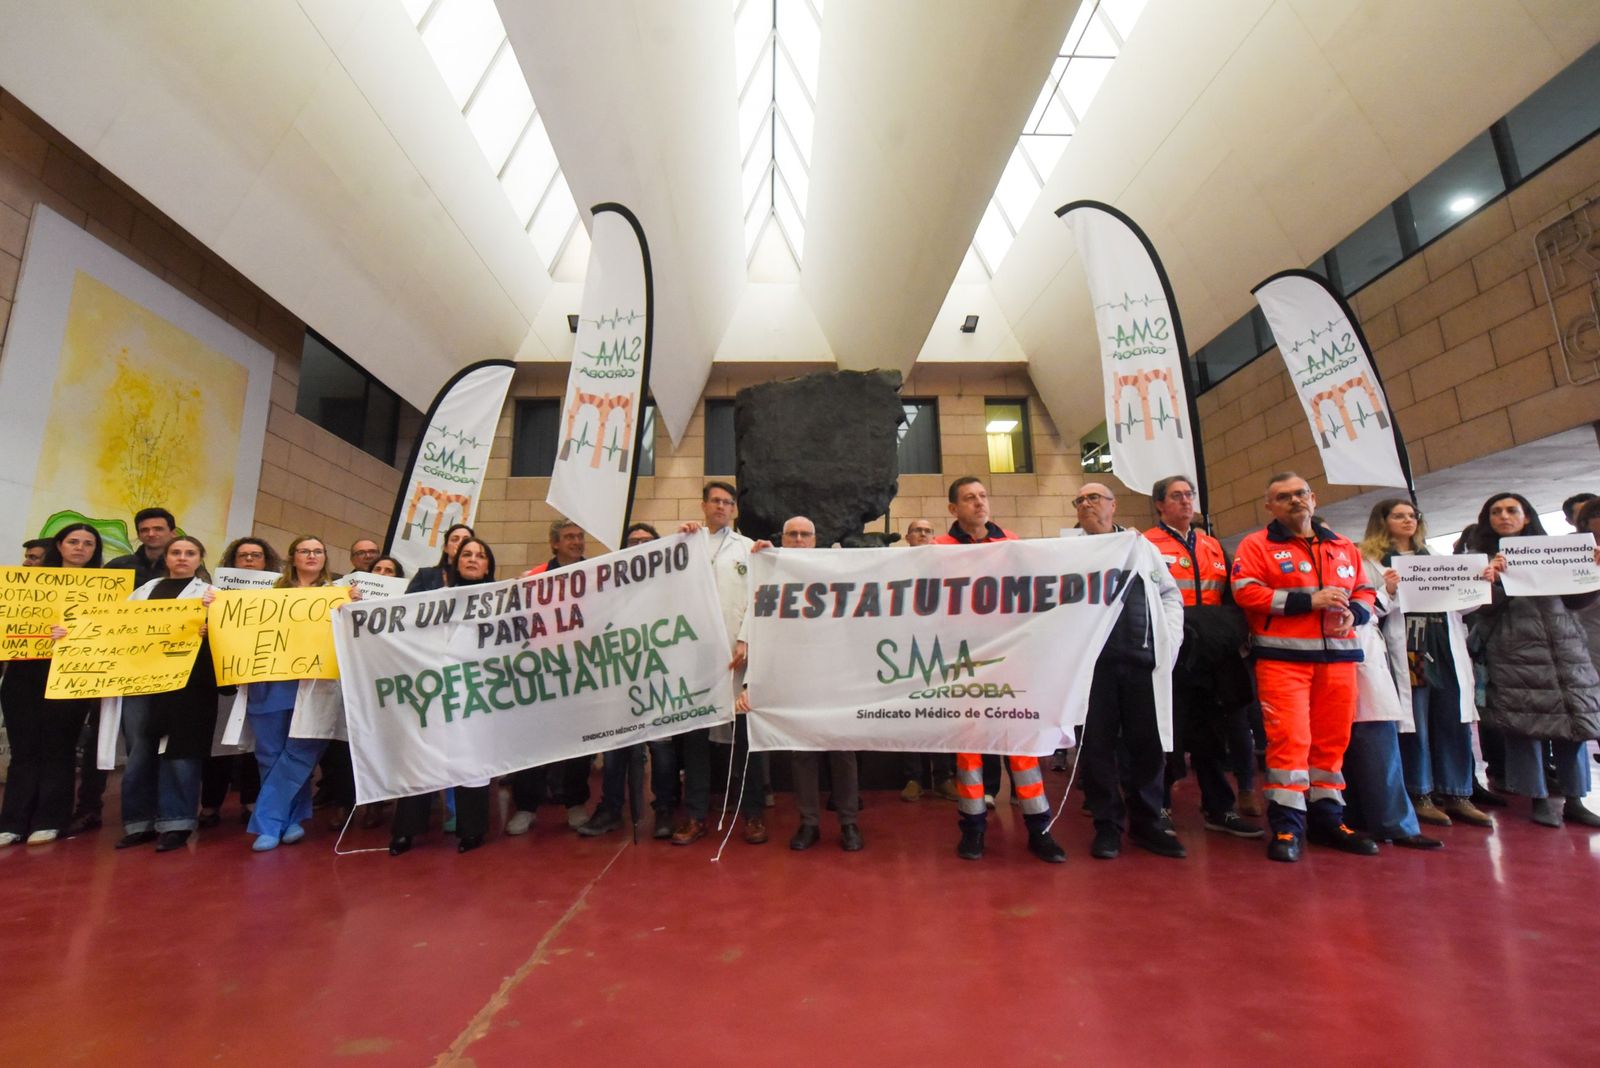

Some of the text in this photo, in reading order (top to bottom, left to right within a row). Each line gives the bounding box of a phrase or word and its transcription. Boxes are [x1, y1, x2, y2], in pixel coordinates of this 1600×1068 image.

[424, 441, 479, 475] SMA
[1543, 544, 1594, 555] quemado
[1539, 555, 1594, 566] colapsado
[1433, 564, 1455, 572] años
[1456, 564, 1469, 572] de
[5, 571, 127, 592] UN CONDUCTOR
[219, 575, 251, 585] “Faltan
[1401, 574, 1426, 583] tudio,
[351, 542, 689, 638] POR UN ESTATUTO PROPIO
[370, 590, 389, 598] para
[1431, 584, 1455, 592] mes”
[64, 590, 90, 603] ES
[97, 592, 119, 603] UN
[0, 603, 54, 619] ELIGRO
[219, 594, 347, 629] MÉDICOS
[6, 621, 53, 635] MÉDIC
[106, 624, 139, 636] AÑOS
[477, 603, 585, 650] PARA LA
[1, 638, 29, 650] UNA
[253, 628, 291, 657] EN
[8, 649, 54, 659] 24 HO
[374, 614, 698, 708] PROFESIÓN MÉDICA
[876, 633, 1006, 687] SMA
[57, 660, 118, 672] NENTE
[221, 654, 324, 681] HUELGA
[408, 648, 670, 728] Y FACULTATIVA
[628, 676, 711, 717] SMA
[856, 706, 1041, 720] Sindicato Médico de Córdoba
[582, 729, 615, 742] SINDICATO
[615, 723, 638, 735] MÉDICO
